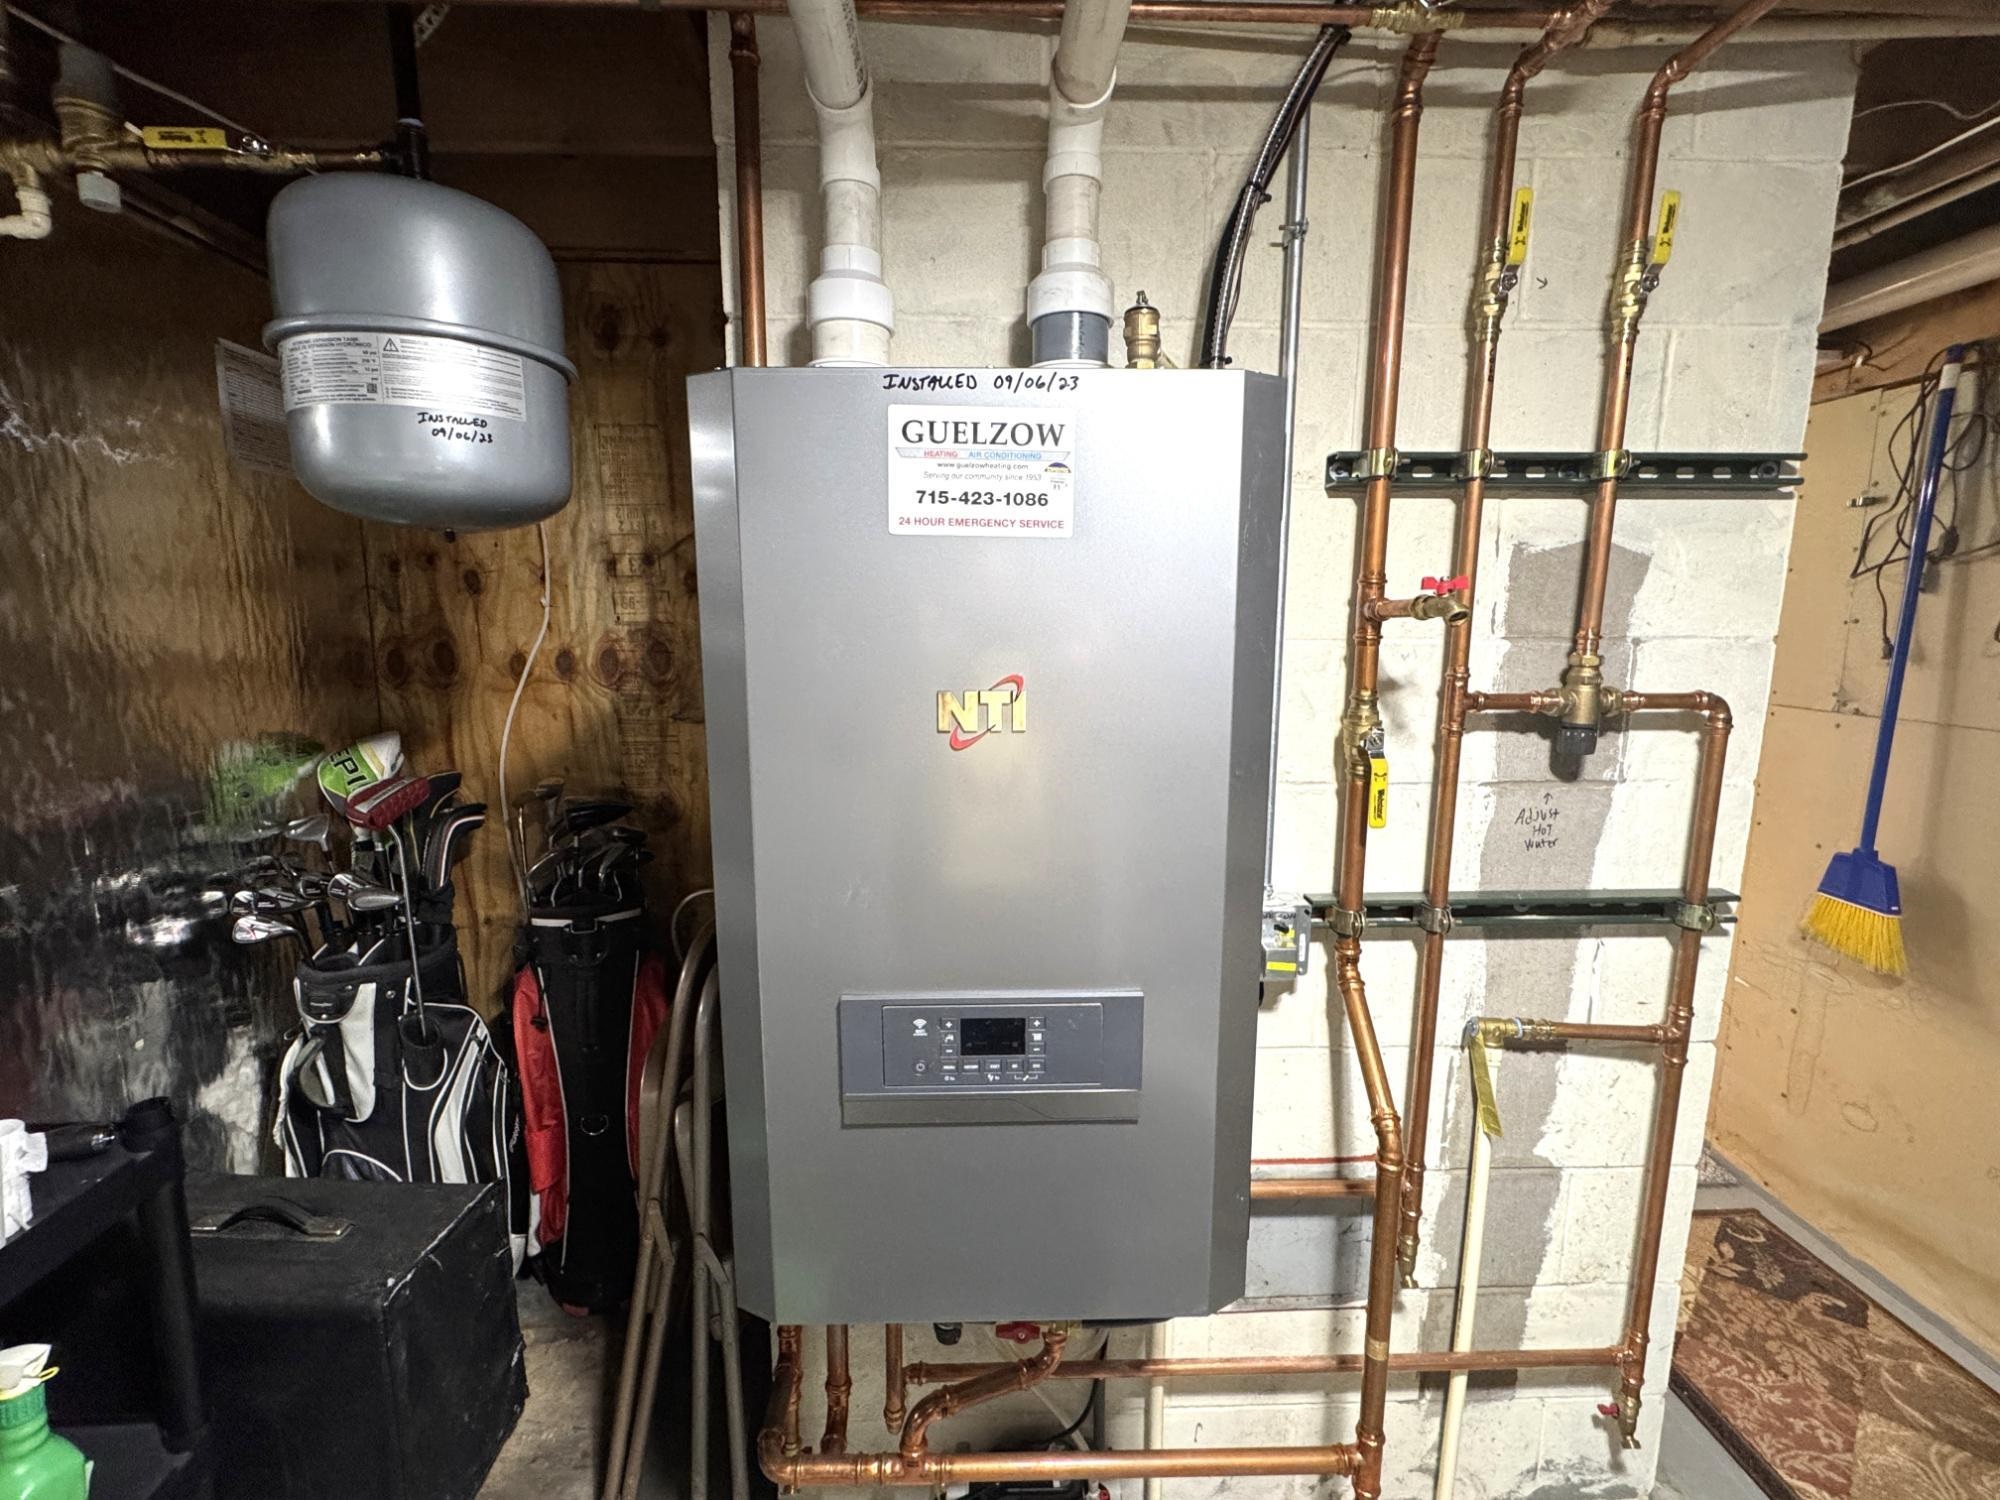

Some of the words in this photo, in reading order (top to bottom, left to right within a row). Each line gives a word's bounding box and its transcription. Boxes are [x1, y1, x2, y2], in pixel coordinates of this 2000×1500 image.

[883, 373, 978, 391] INSTALLED
[993, 371, 1079, 394] 09/06/23
[417, 412, 488, 428] INSTALLED
[431, 427, 493, 444] 09/06/23
[901, 419, 1066, 447] GUELZOW
[924, 450, 958, 458] HEATING
[968, 451, 982, 459] AIR
[984, 451, 1042, 460] CONDITIONING
[923, 471, 949, 481] Serving
[964, 473, 1003, 482] community
[1004, 473, 1023, 481] since
[916, 490, 1049, 507] 715-423-1086
[898, 516, 911, 526] 24
[914, 517, 945, 527] HOUR
[948, 518, 1016, 528] EMERGENCY
[1019, 519, 1065, 529] SERVICE
[937, 690, 1026, 733] NTI
[1514, 808, 1560, 825] Adjust
